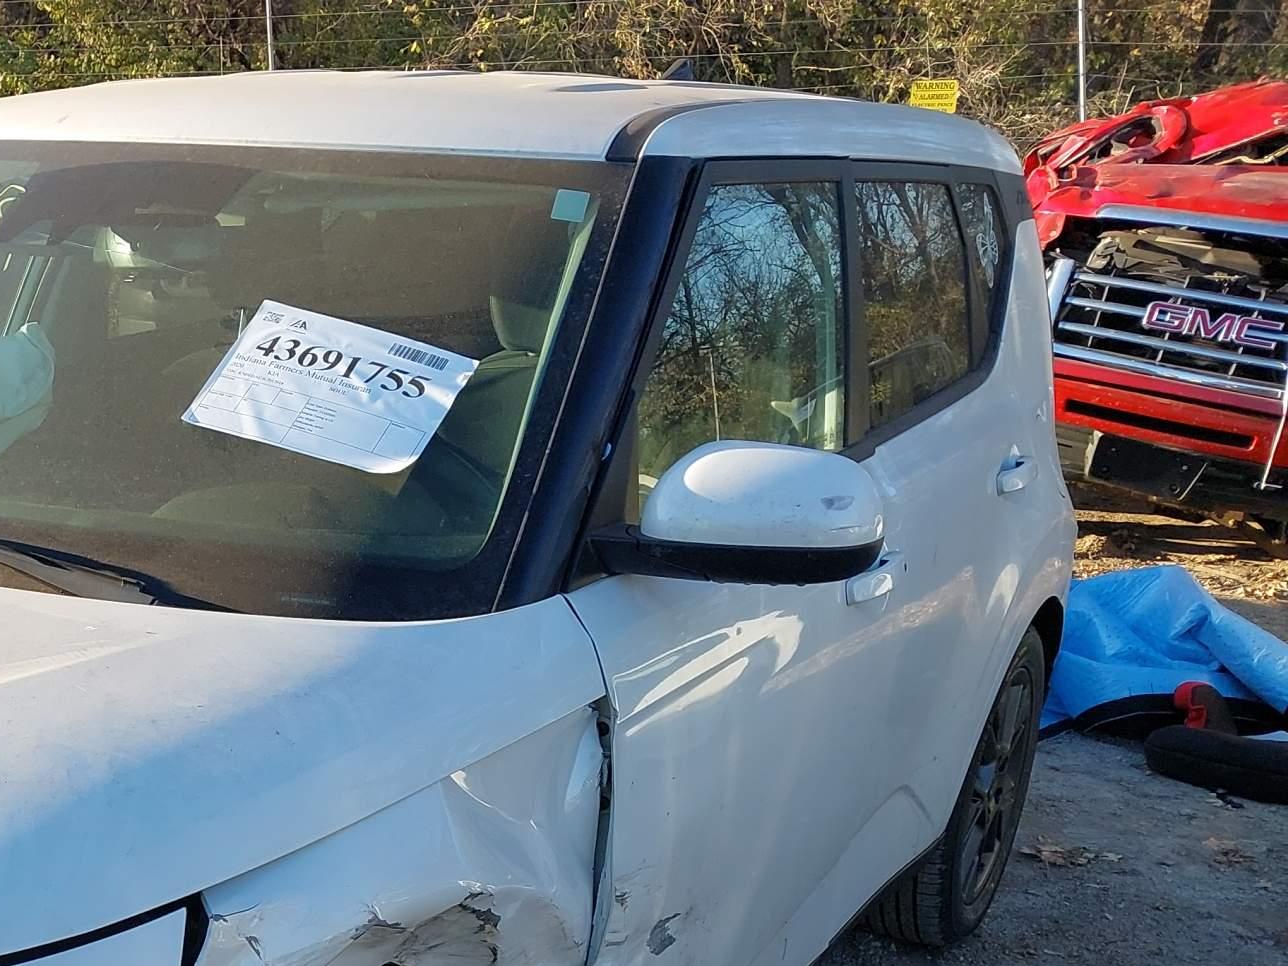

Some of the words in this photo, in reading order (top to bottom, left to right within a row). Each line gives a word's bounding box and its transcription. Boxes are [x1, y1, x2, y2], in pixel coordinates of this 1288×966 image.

[915, 82, 955, 90] WARNING
[1143, 300, 1285, 350] GMC
[235, 353, 267, 366] Indiana
[268, 360, 305, 375] Farmers
[305, 370, 338, 385] Mutual
[338, 378, 372, 394] Insuran
[255, 335, 433, 399] 43691755
